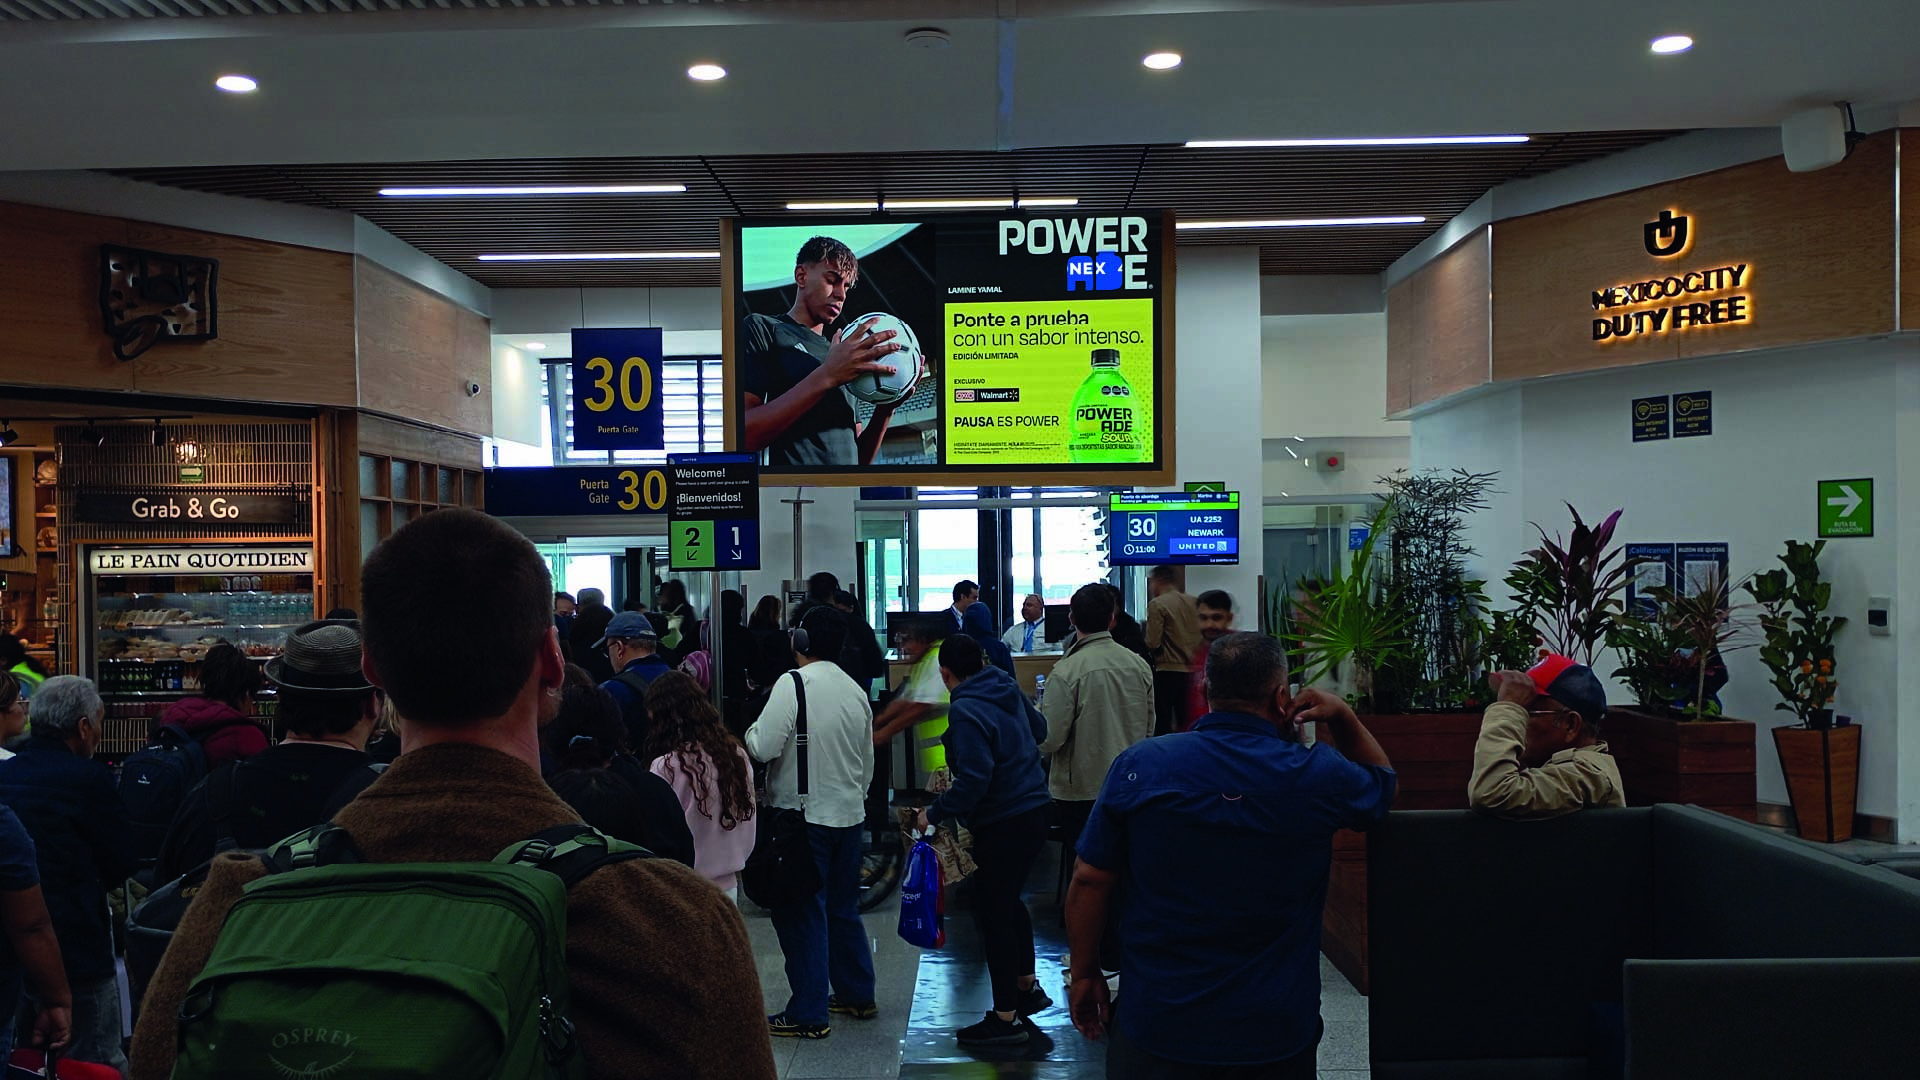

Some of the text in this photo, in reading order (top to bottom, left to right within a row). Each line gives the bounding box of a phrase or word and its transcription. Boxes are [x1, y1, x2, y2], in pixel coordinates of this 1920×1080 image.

[999, 216, 1148, 255] POWER
[947, 286, 977, 294] LAMINE
[953, 310, 1089, 329] Ponte a prueba
[1592, 296, 1746, 340] DUTY FREE
[953, 328, 1144, 347] con un sabor intenso.
[953, 352, 1019, 360] EDICIÓN LIMITADA
[583, 356, 652, 412] 30
[954, 416, 1060, 427] PAUSA ES POWER
[1076, 408, 1133, 421] POWER
[597, 425, 639, 433] Puerta Gate
[1101, 421, 1133, 432] ADE
[1101, 432, 1134, 443] SOUR
[675, 468, 726, 479] Welcome!
[580, 470, 668, 511] Puerta 30
[588, 493, 610, 504] Gate
[676, 492, 742, 505] ¡Bienvenidos!
[131, 498, 239, 519] Grab & Go
[1129, 518, 1156, 537] 30
[1187, 529, 1224, 537] NEWARK
[685, 528, 700, 546] 2
[731, 526, 740, 545] 1
[1135, 545, 1156, 553] 11:00
[97, 552, 308, 569] LE PAIN QUOTIDIEN
[271, 1027, 359, 1048] OSPREY
